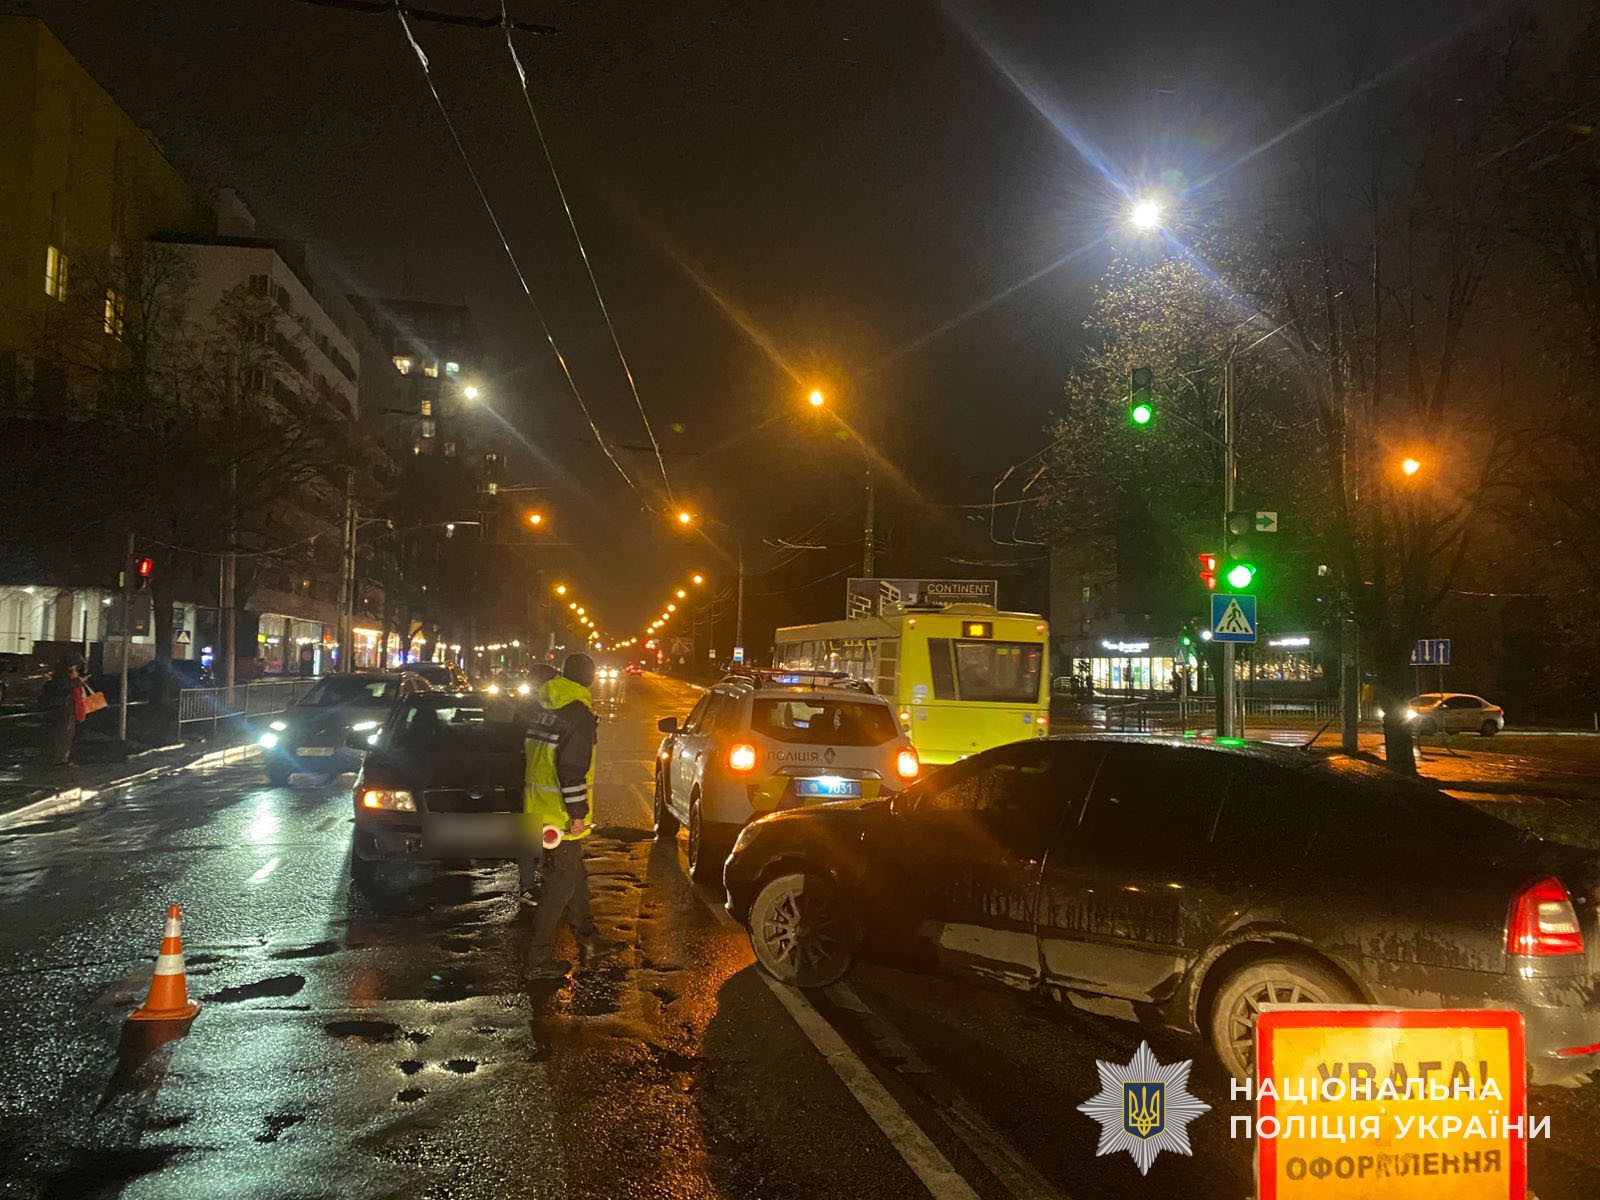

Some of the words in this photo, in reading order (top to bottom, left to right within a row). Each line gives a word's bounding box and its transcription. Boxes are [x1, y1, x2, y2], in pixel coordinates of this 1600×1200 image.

[926, 583, 990, 594] CONTINENT
[767, 751, 819, 762] ПОЛІЦІЯ
[1317, 1060, 1489, 1102] УВАГА!
